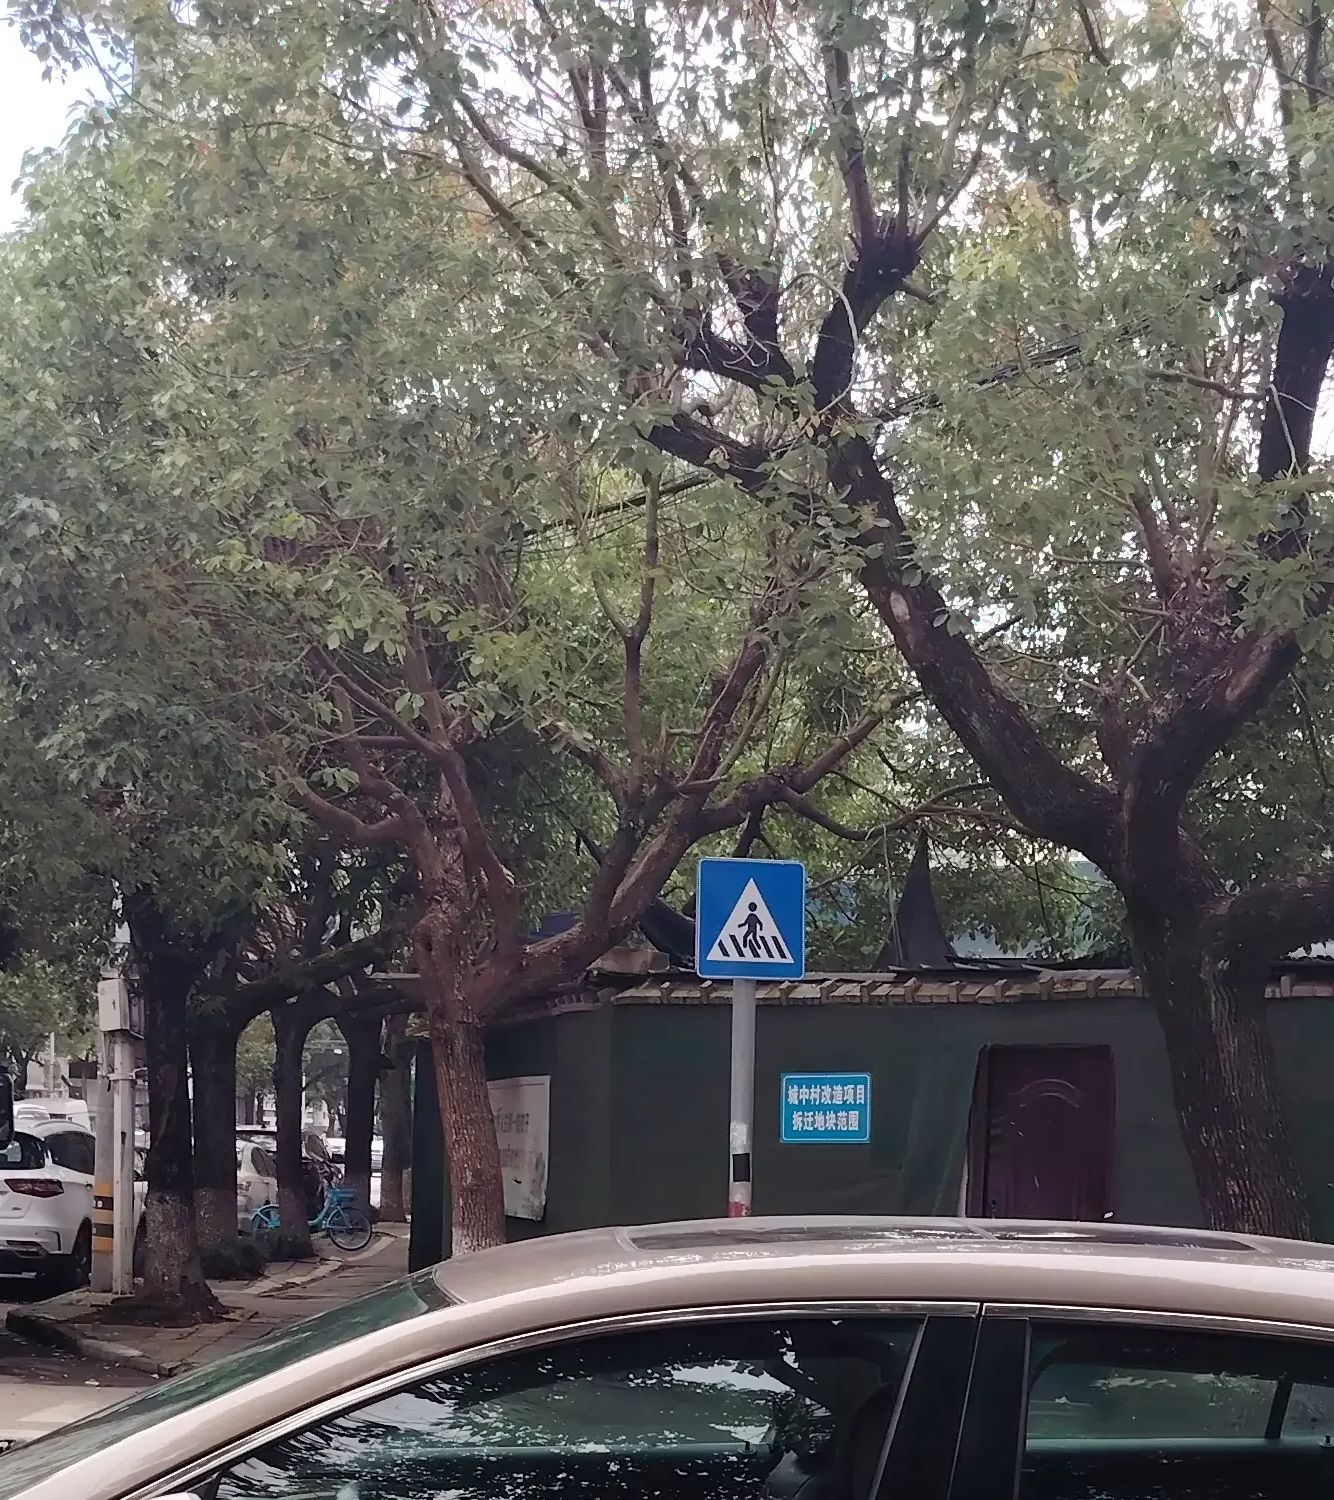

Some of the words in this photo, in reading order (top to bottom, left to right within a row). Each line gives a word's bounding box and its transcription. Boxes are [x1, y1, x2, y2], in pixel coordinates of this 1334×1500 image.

[787, 1084, 864, 1105] 城中村改造项目
[792, 1110, 858, 1131] 拆迁地块范围
